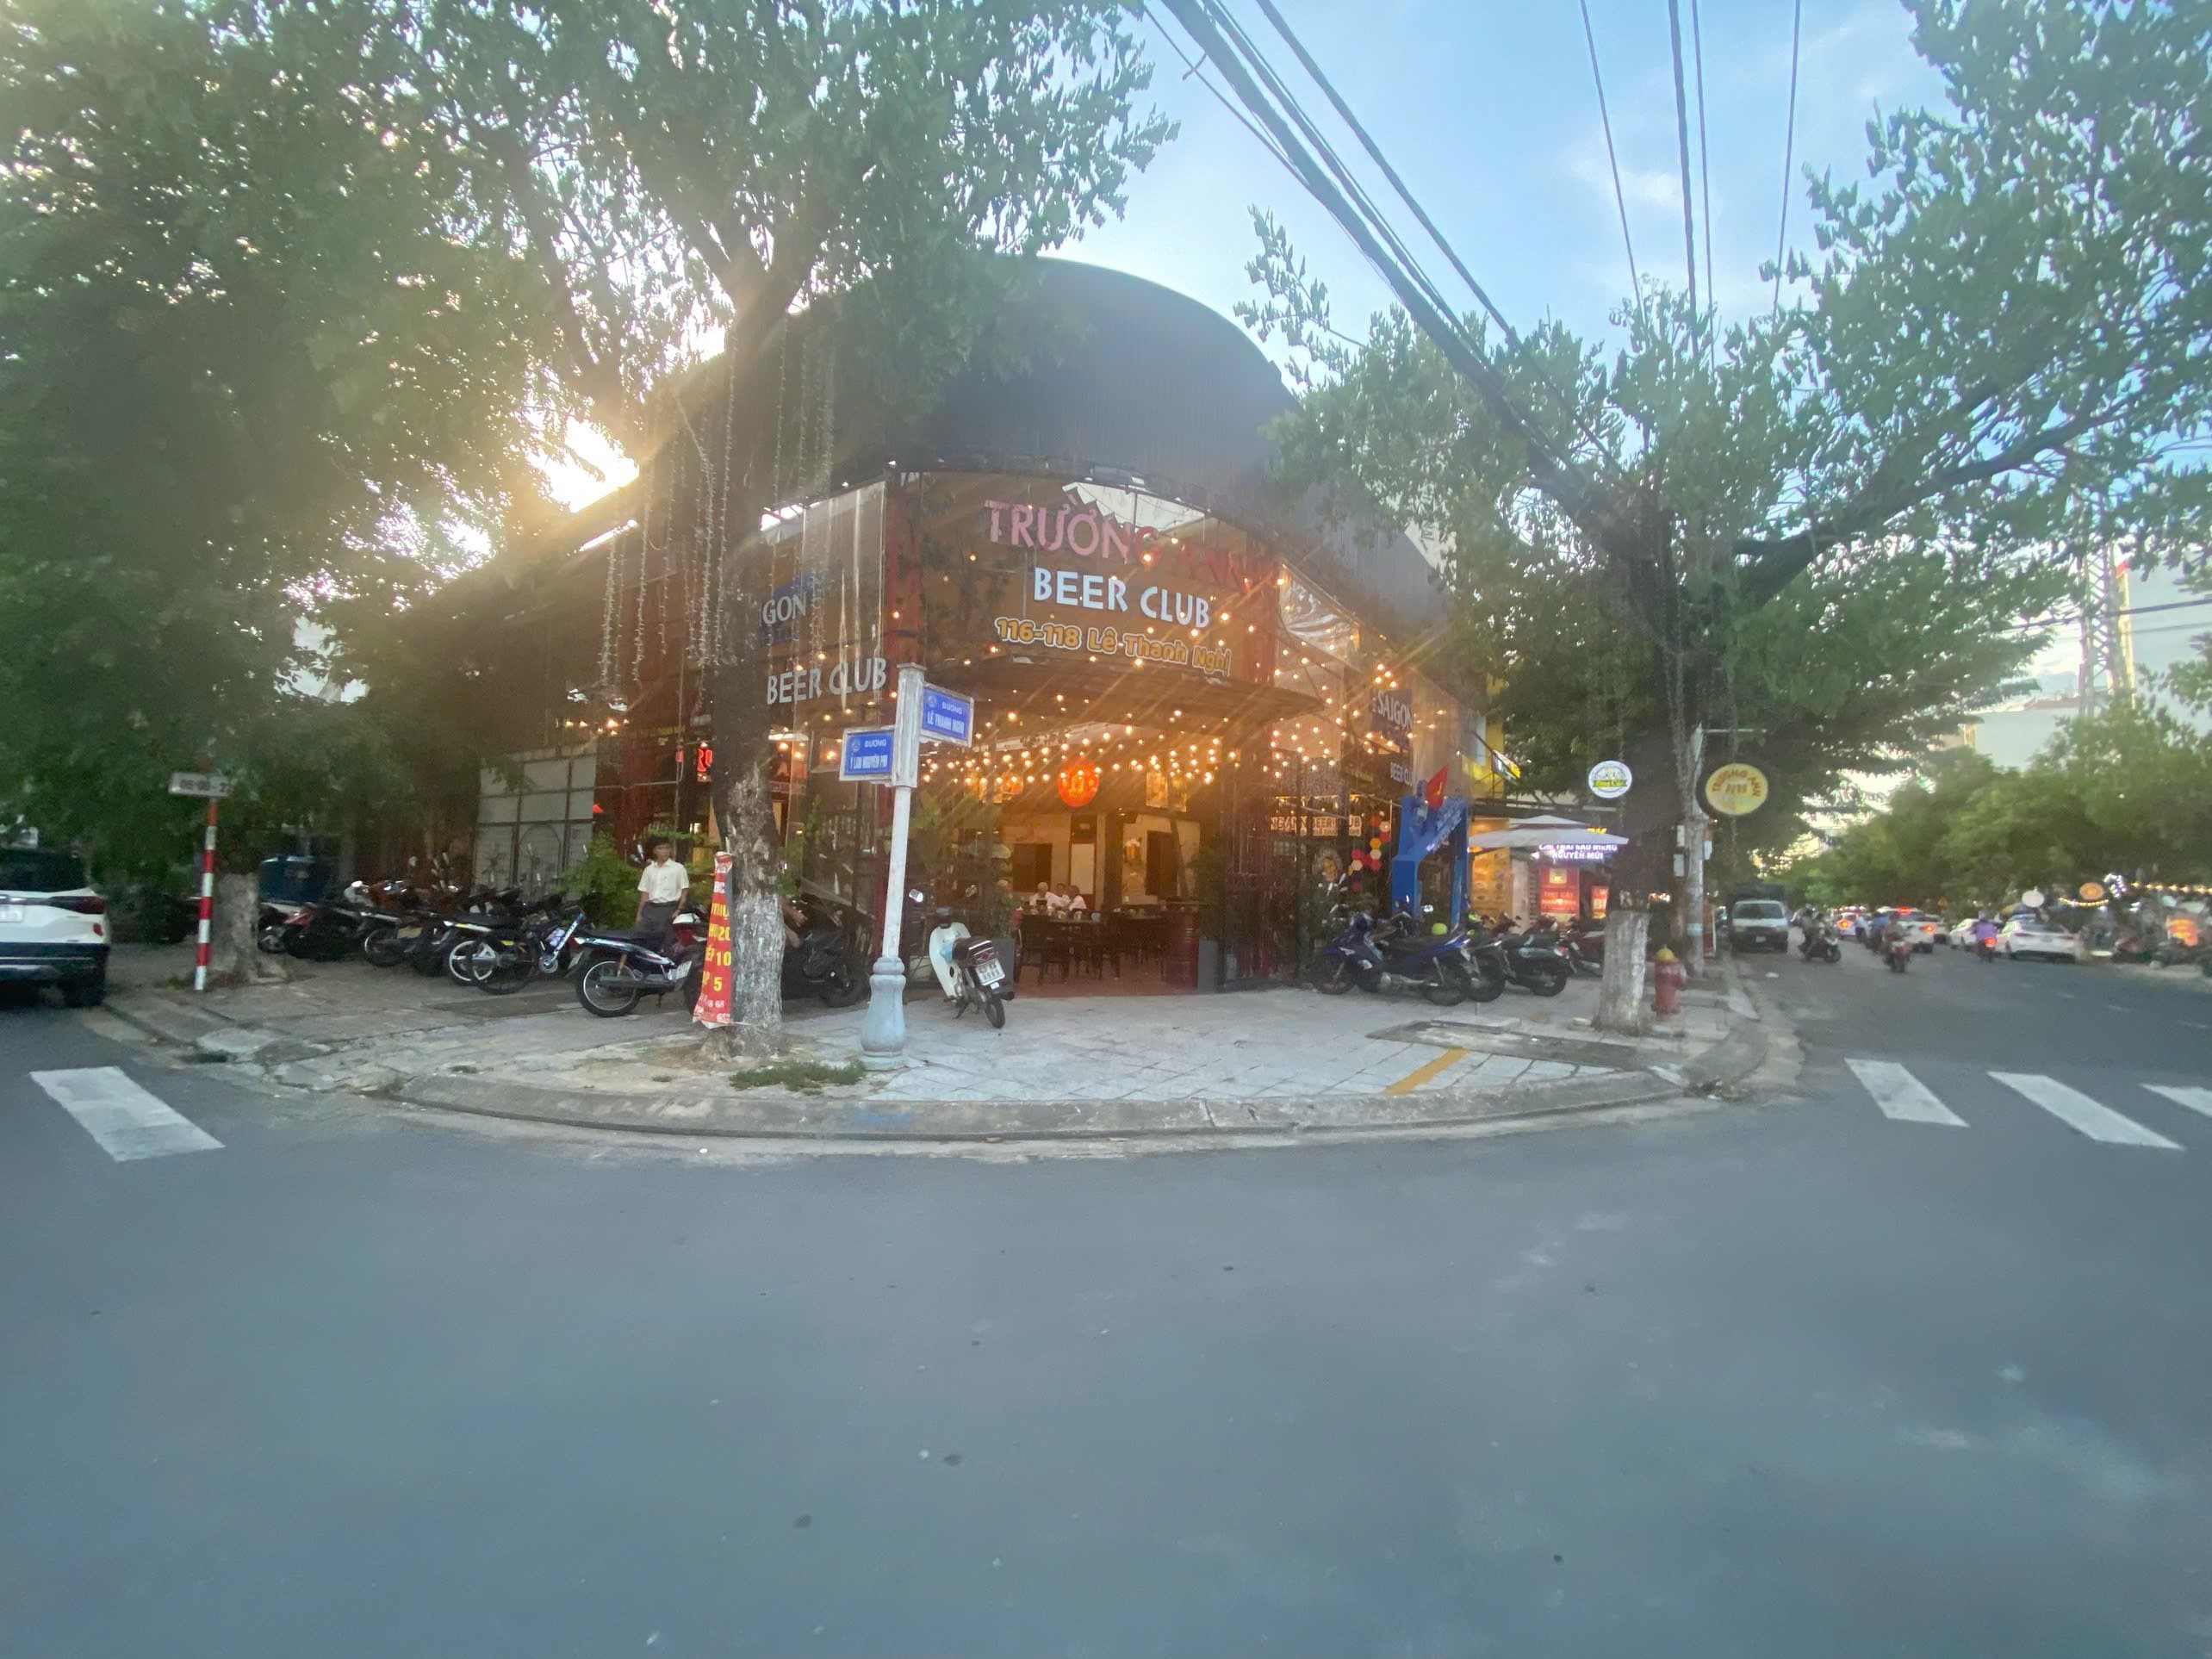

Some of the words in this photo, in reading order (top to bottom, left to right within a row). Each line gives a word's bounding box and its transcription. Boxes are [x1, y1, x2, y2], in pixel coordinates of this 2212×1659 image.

[1034, 567, 1128, 612] BEER
[1140, 586, 1209, 628] CLUB
[994, 617, 1082, 649] 116-118
[1086, 626, 1119, 655] Lê
[1122, 633, 1190, 665] Thanh
[767, 668, 823, 705] BEER
[829, 657, 886, 695] CLUB
[717, 951, 731, 966] 10
[713, 977, 723, 991] 5
